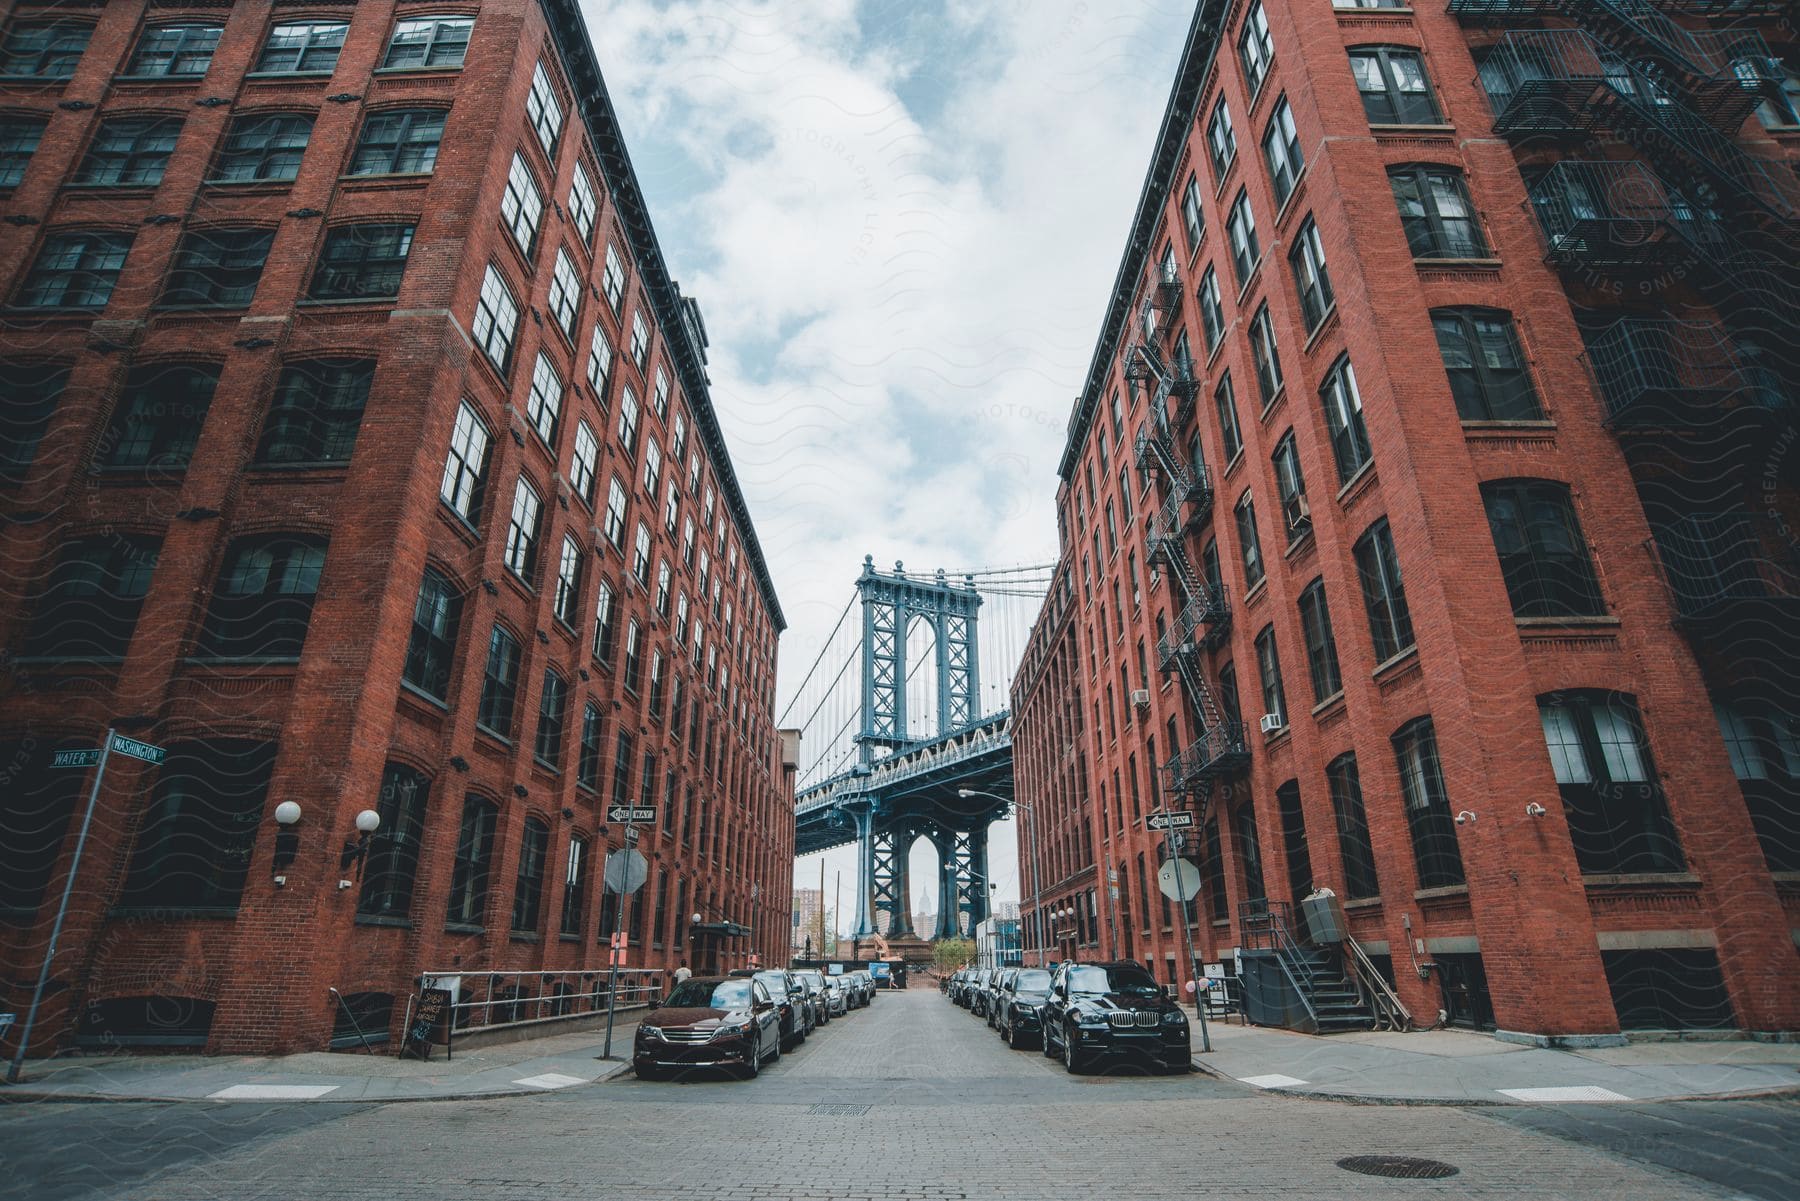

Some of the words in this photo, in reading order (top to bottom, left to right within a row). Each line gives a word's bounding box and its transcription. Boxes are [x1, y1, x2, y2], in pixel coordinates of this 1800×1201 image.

[114, 737, 158, 761] WASHINGTON
[54, 752, 86, 766] WATER
[614, 810, 629, 819] ONE
[635, 810, 650, 819] WAY
[1153, 818, 1168, 826] ONE
[1172, 816, 1187, 824] WAY
